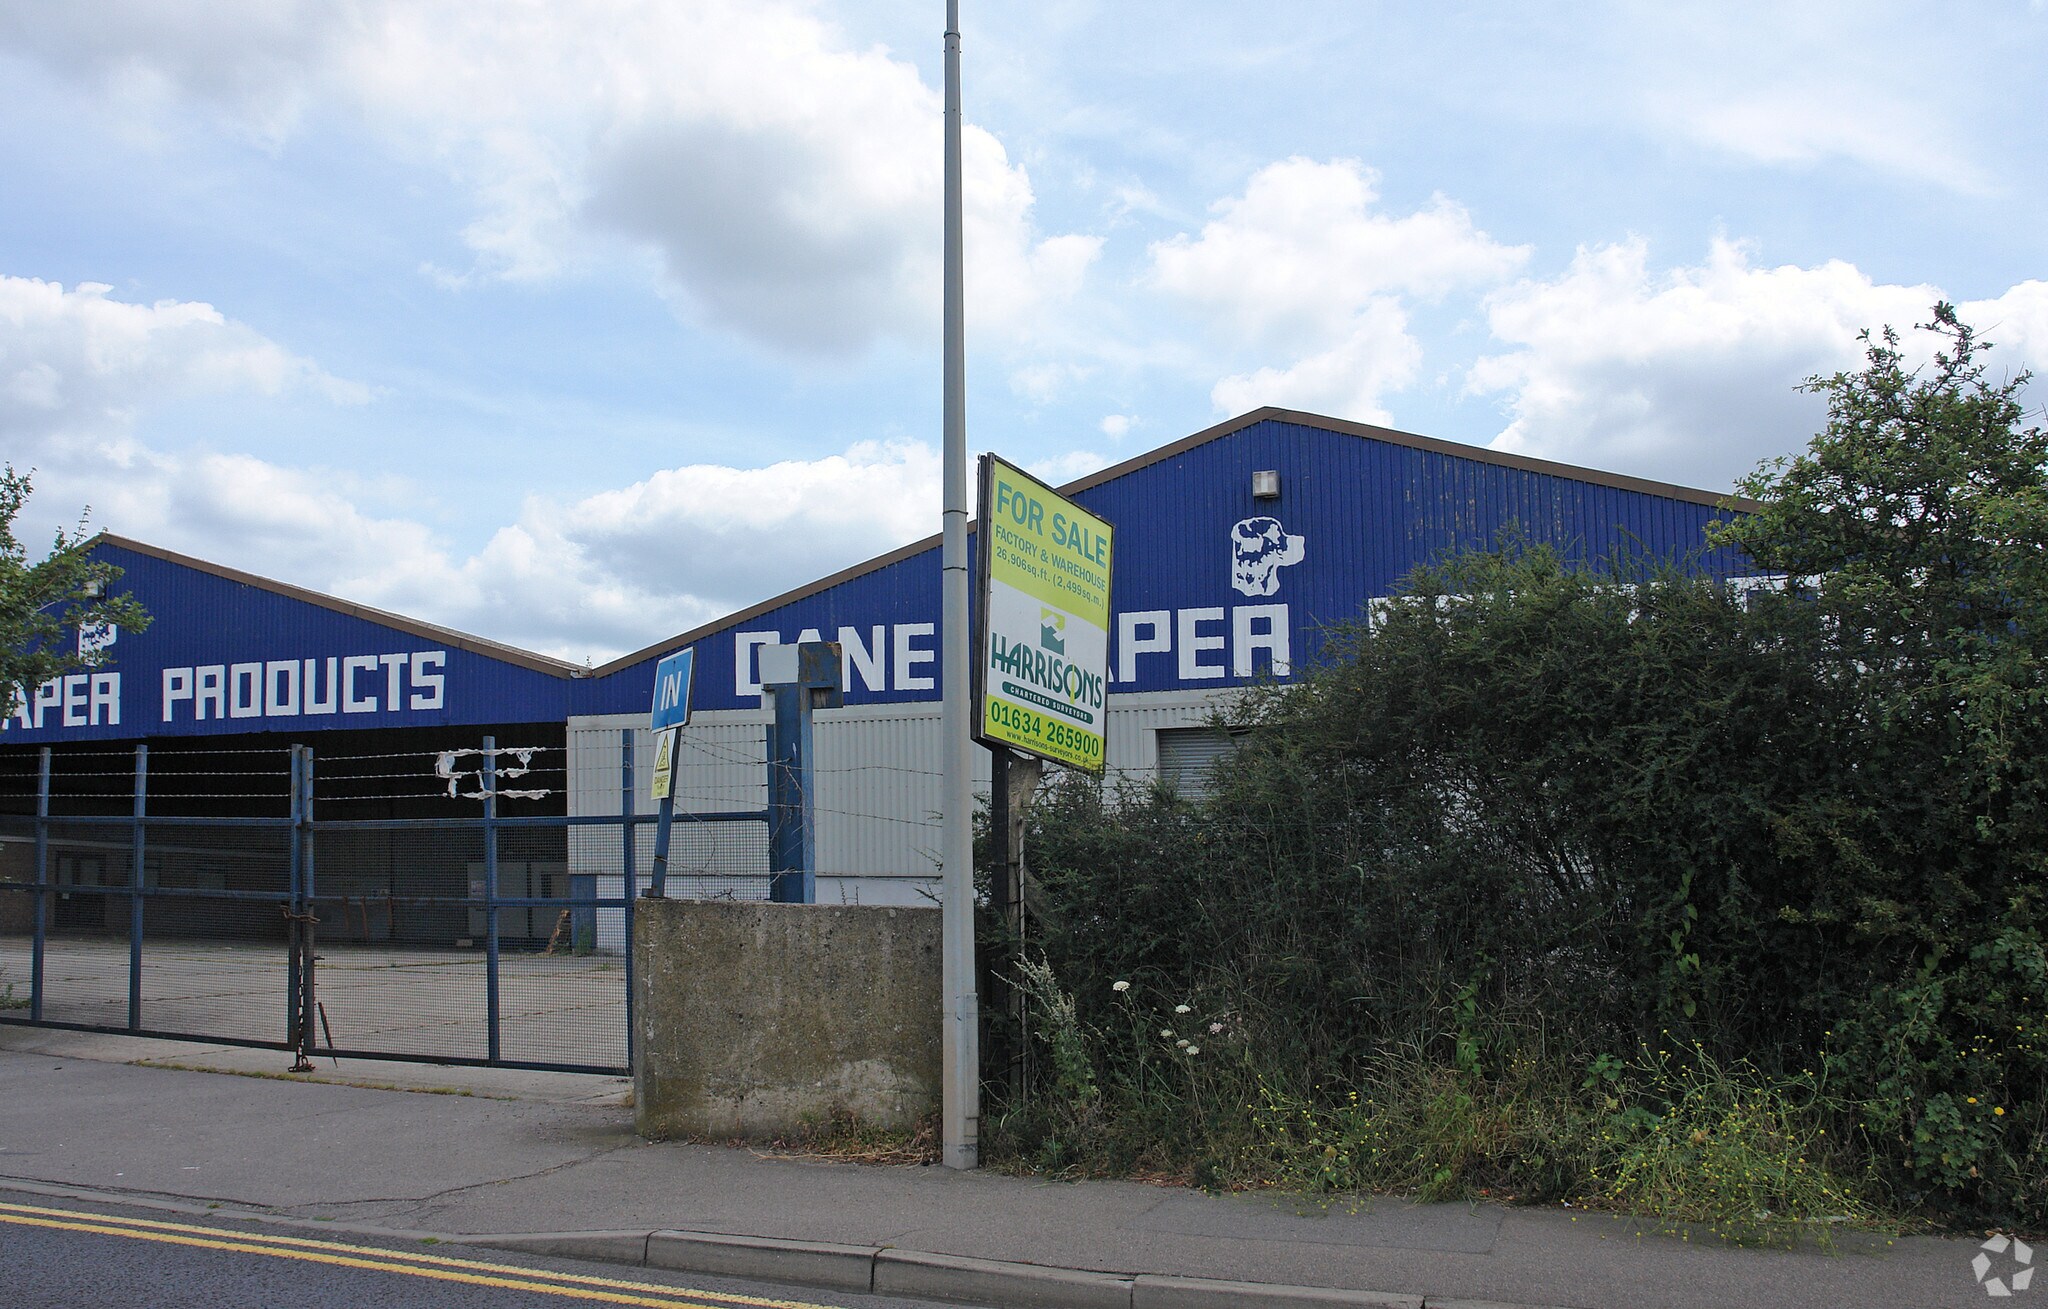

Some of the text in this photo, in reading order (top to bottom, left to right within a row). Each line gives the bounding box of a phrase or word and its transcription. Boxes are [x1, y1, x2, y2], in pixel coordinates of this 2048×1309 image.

[996, 524, 1106, 592] FACTORY & WAREHOUSE
[997, 480, 1107, 569] FOR SALE
[735, 623, 935, 696] DNE
[1108, 603, 1290, 683] PER
[991, 632, 1103, 709] HARRISONS
[162, 651, 446, 722] PRODUCTS
[660, 671, 682, 711] IN
[1010, 686, 1088, 721] CHARTERED SURVEYORS
[991, 701, 1099, 757] 01634 265900
